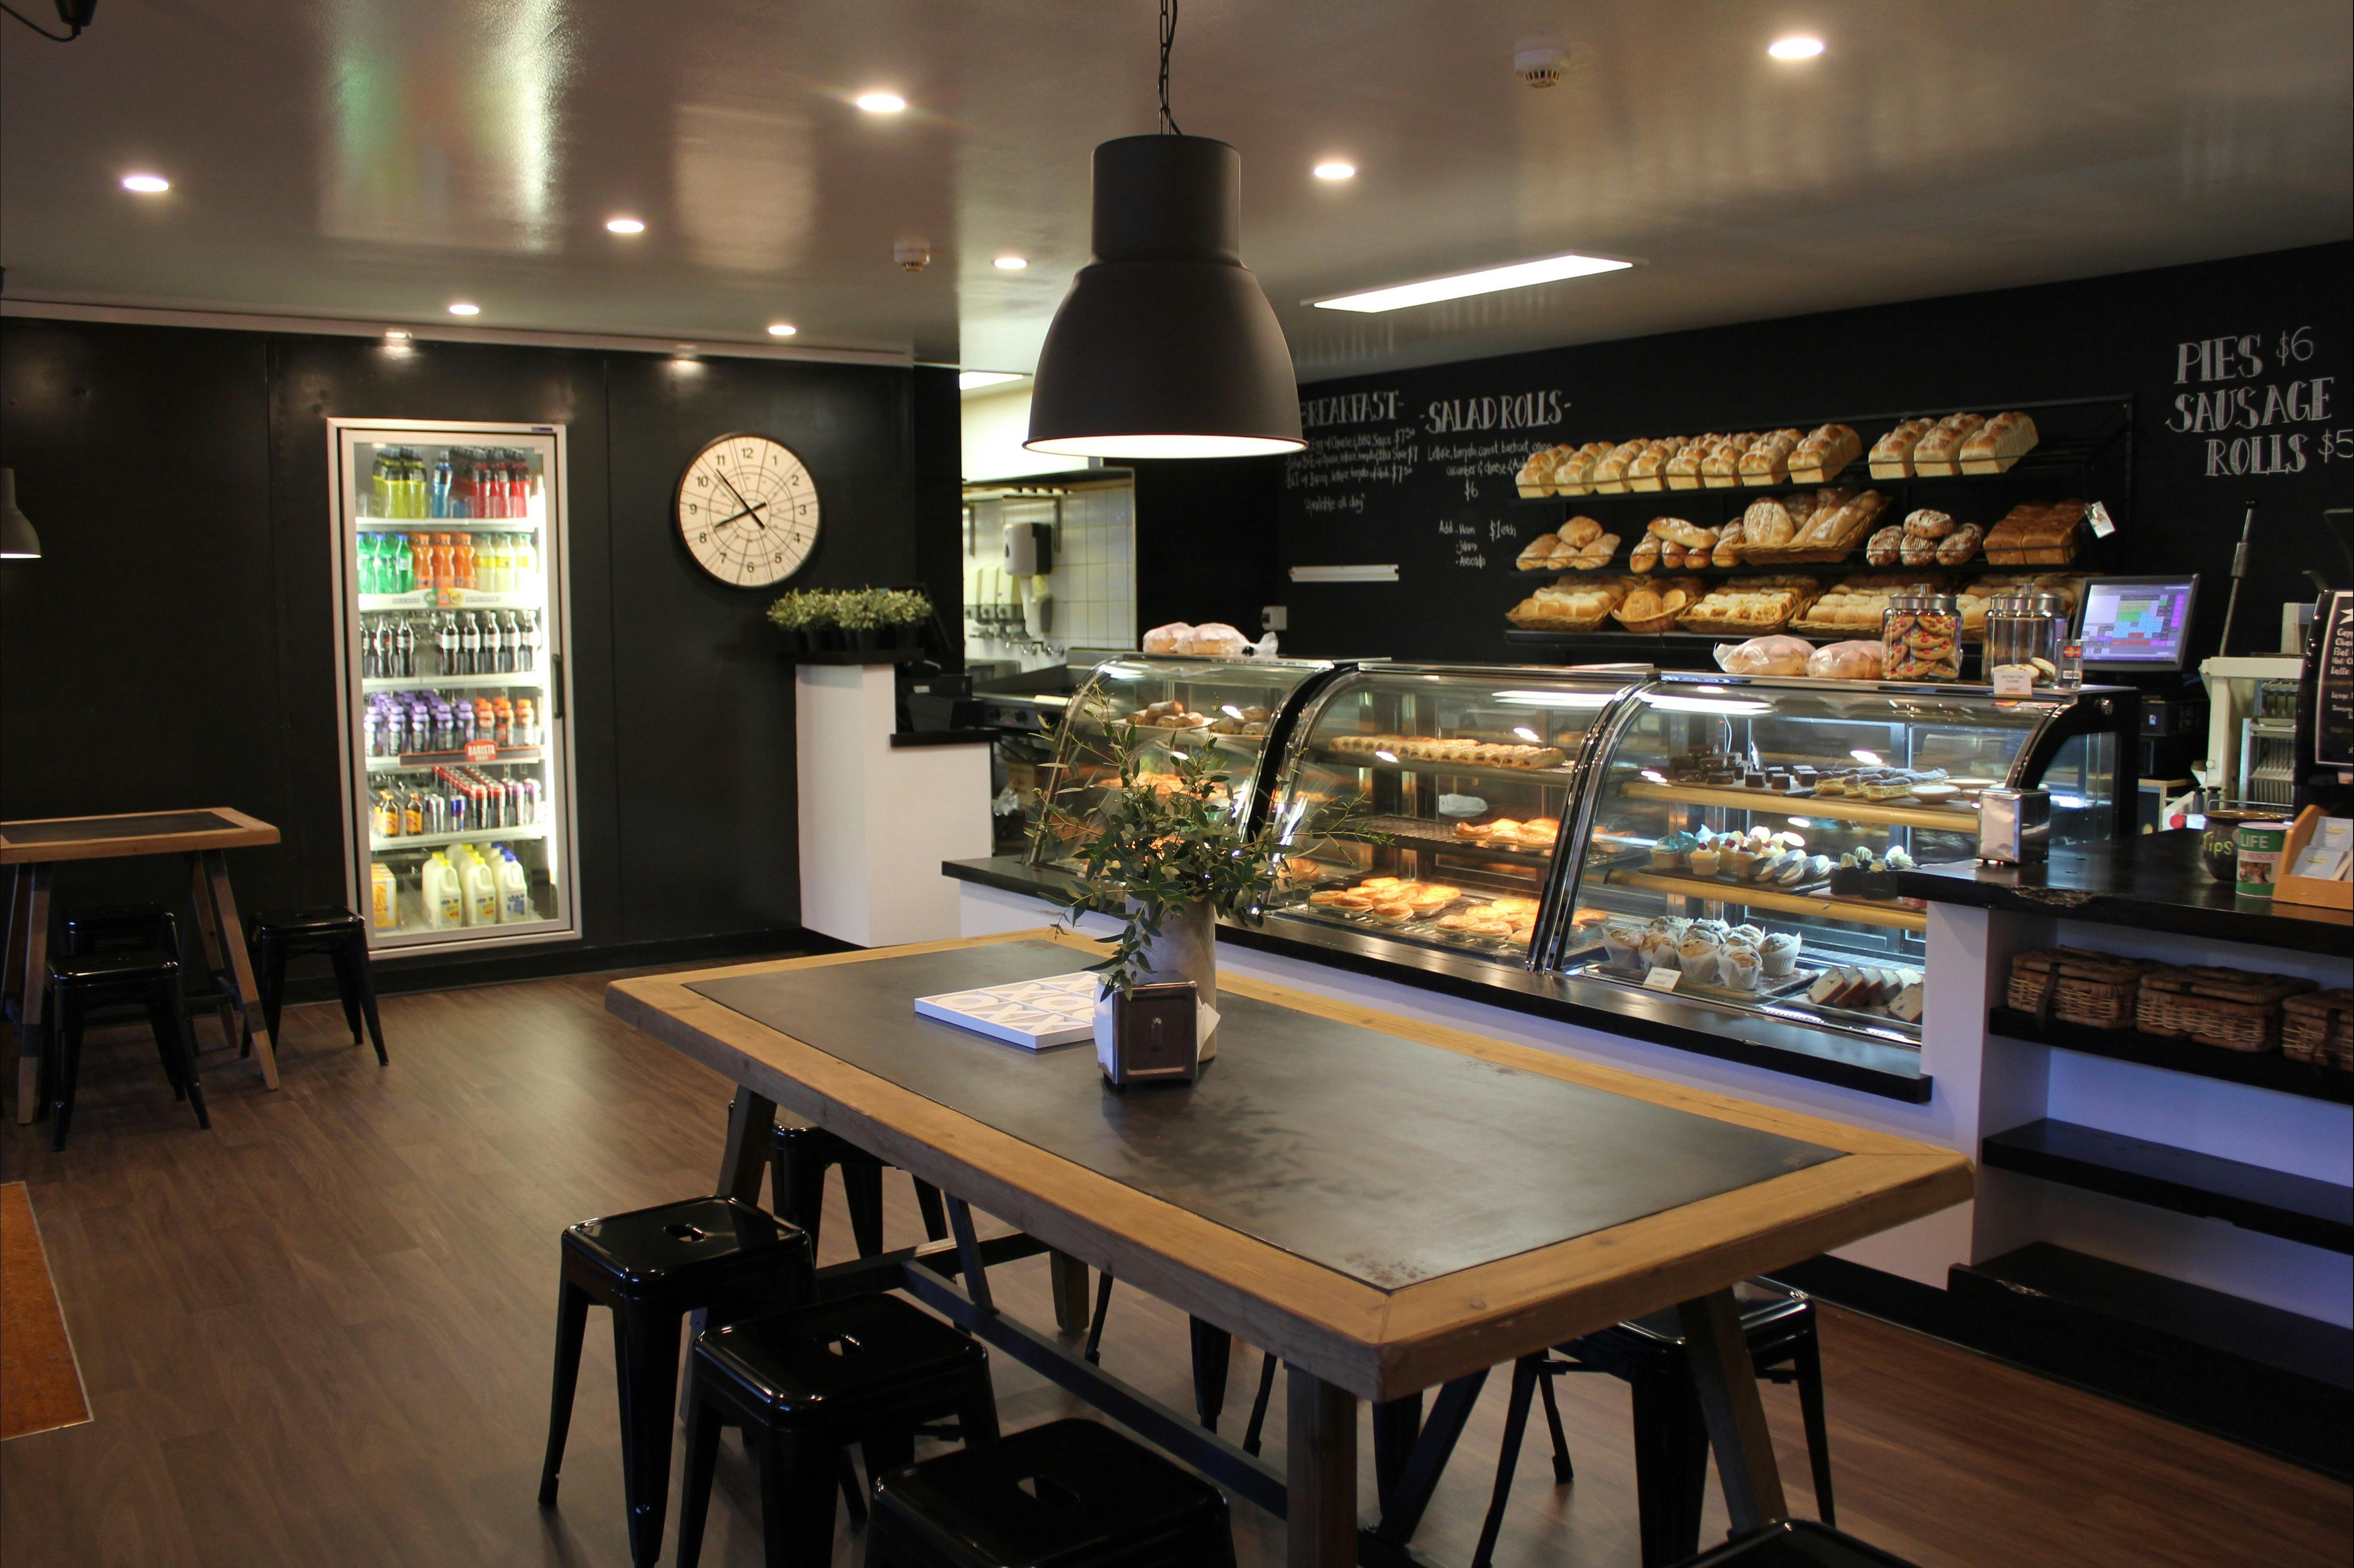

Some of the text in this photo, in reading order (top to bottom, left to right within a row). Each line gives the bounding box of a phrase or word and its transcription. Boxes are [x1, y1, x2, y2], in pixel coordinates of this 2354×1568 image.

[2173, 326, 2314, 384] PIES $6
[2165, 377, 2335, 433] SAUSAGE
[741, 447, 754, 459] 12
[2204, 434, 2309, 477] ROLLS
[716, 455, 726, 466] 11
[772, 454, 777, 466] 1
[697, 476, 708, 488] 10
[790, 474, 799, 486] 2
[1464, 478, 1479, 502] $6
[689, 504, 698, 515] 9
[799, 504, 806, 515] 3
[698, 532, 707, 544] 8
[793, 532, 801, 543] 4
[718, 552, 727, 564] 7
[774, 553, 782, 564] 5
[747, 561, 755, 573] 6
[467, 744, 496, 757] BARISTA
[2202, 831, 2234, 859] Tips
